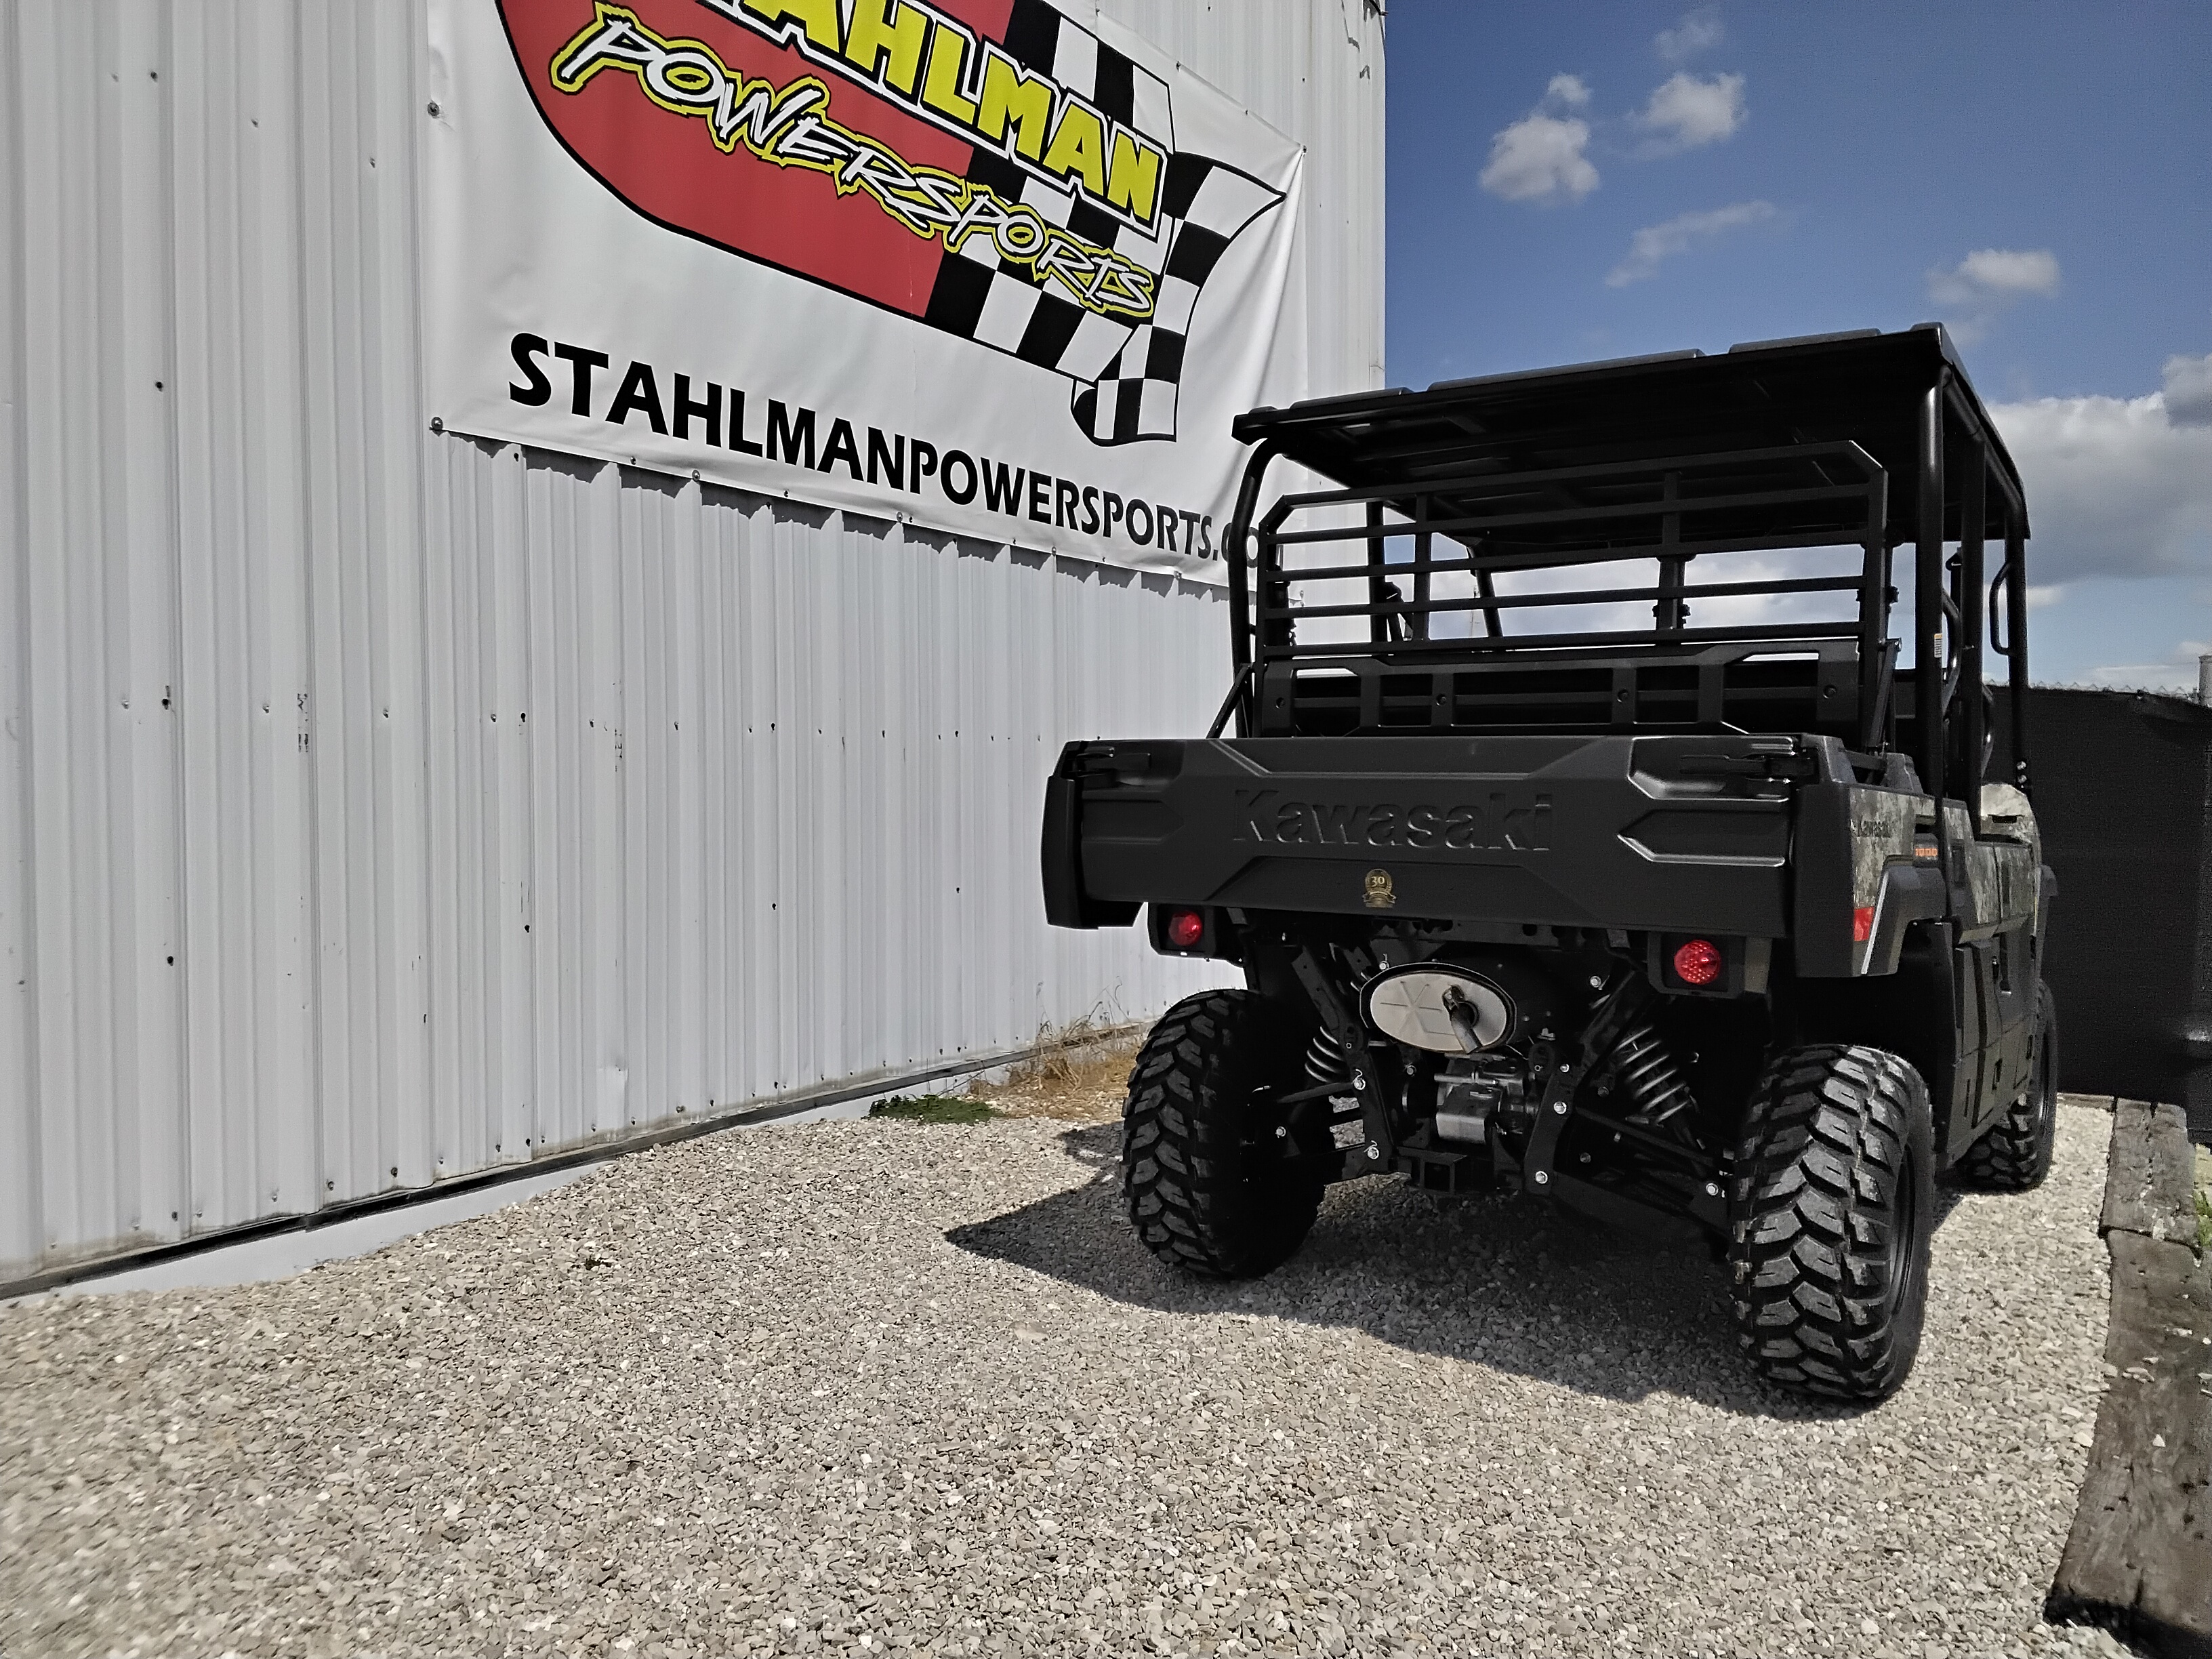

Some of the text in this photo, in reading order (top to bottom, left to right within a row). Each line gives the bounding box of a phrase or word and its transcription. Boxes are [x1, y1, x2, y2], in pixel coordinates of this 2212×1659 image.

[556, 10, 1153, 316] POWERSPORTS
[1233, 789, 1553, 851] Kawasaki
[1370, 876, 1385, 888] 30
